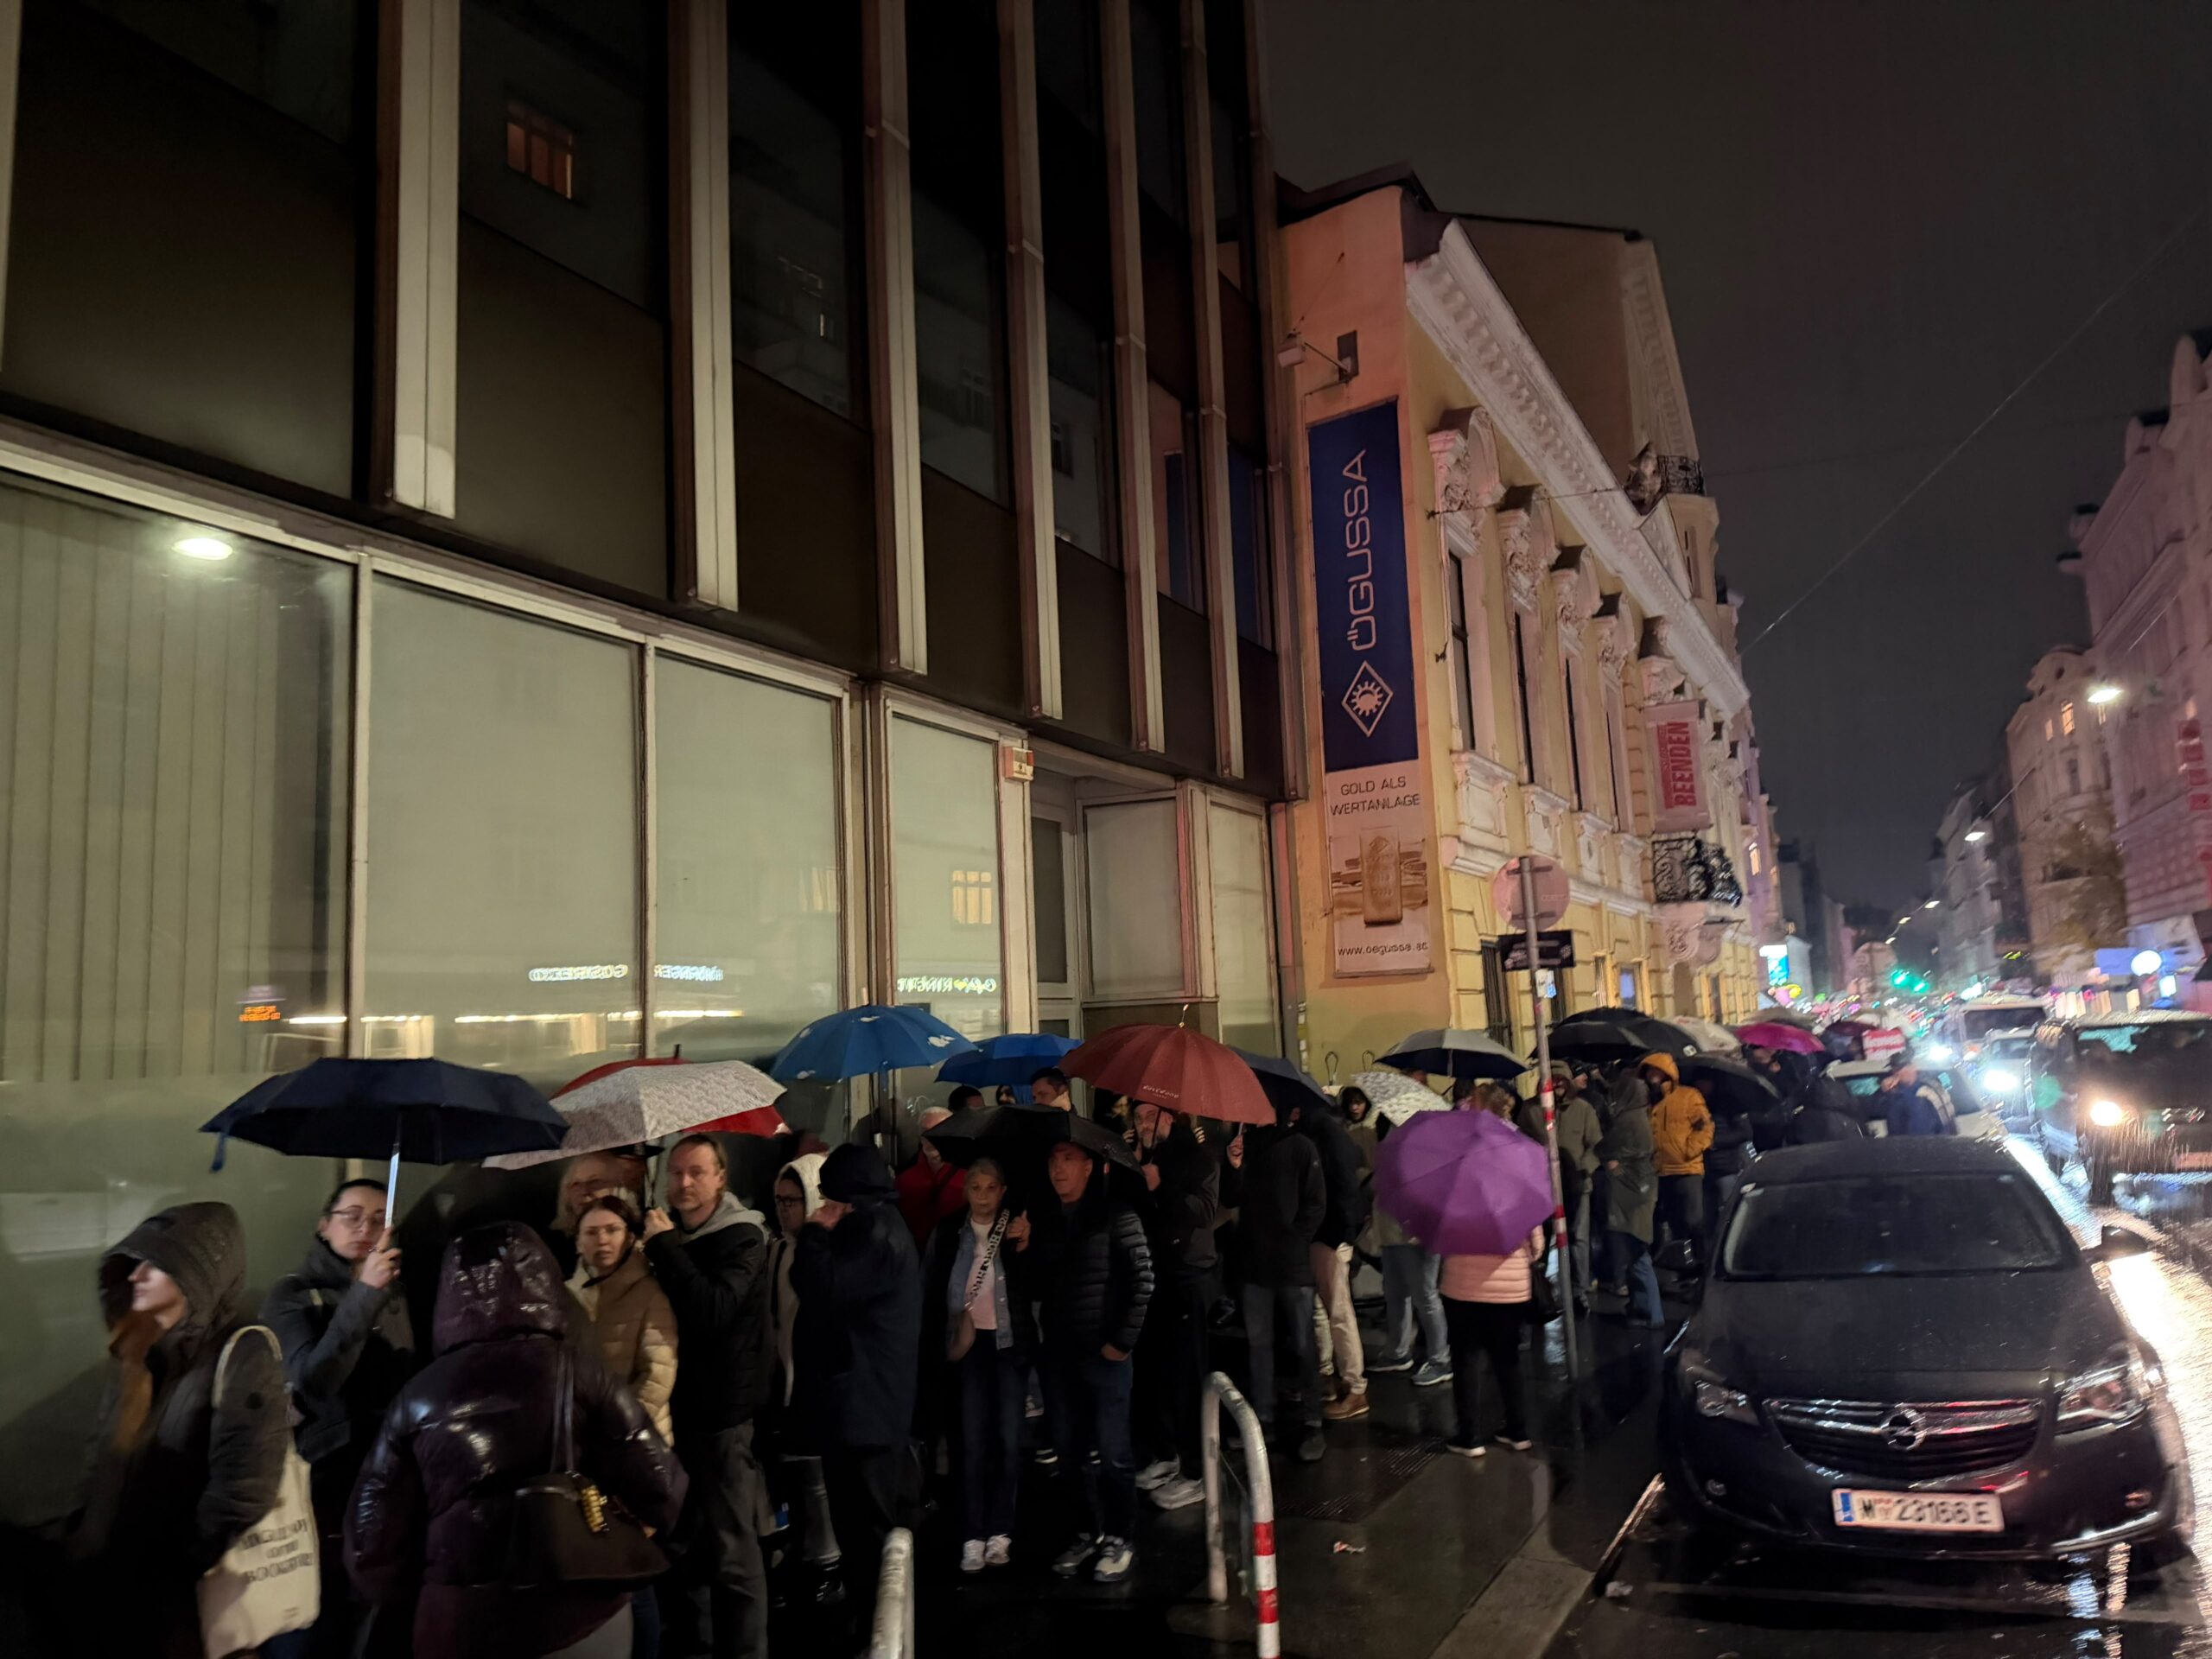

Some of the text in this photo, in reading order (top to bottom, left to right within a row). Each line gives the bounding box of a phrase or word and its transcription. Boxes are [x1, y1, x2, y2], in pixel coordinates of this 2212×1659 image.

[1342, 448, 1376, 652] ÖGUSSA
[1340, 776, 1407, 797] GOLD ALS
[1666, 721, 1697, 808] BEENDEN
[1330, 793, 1421, 817] WERTANLAGE
